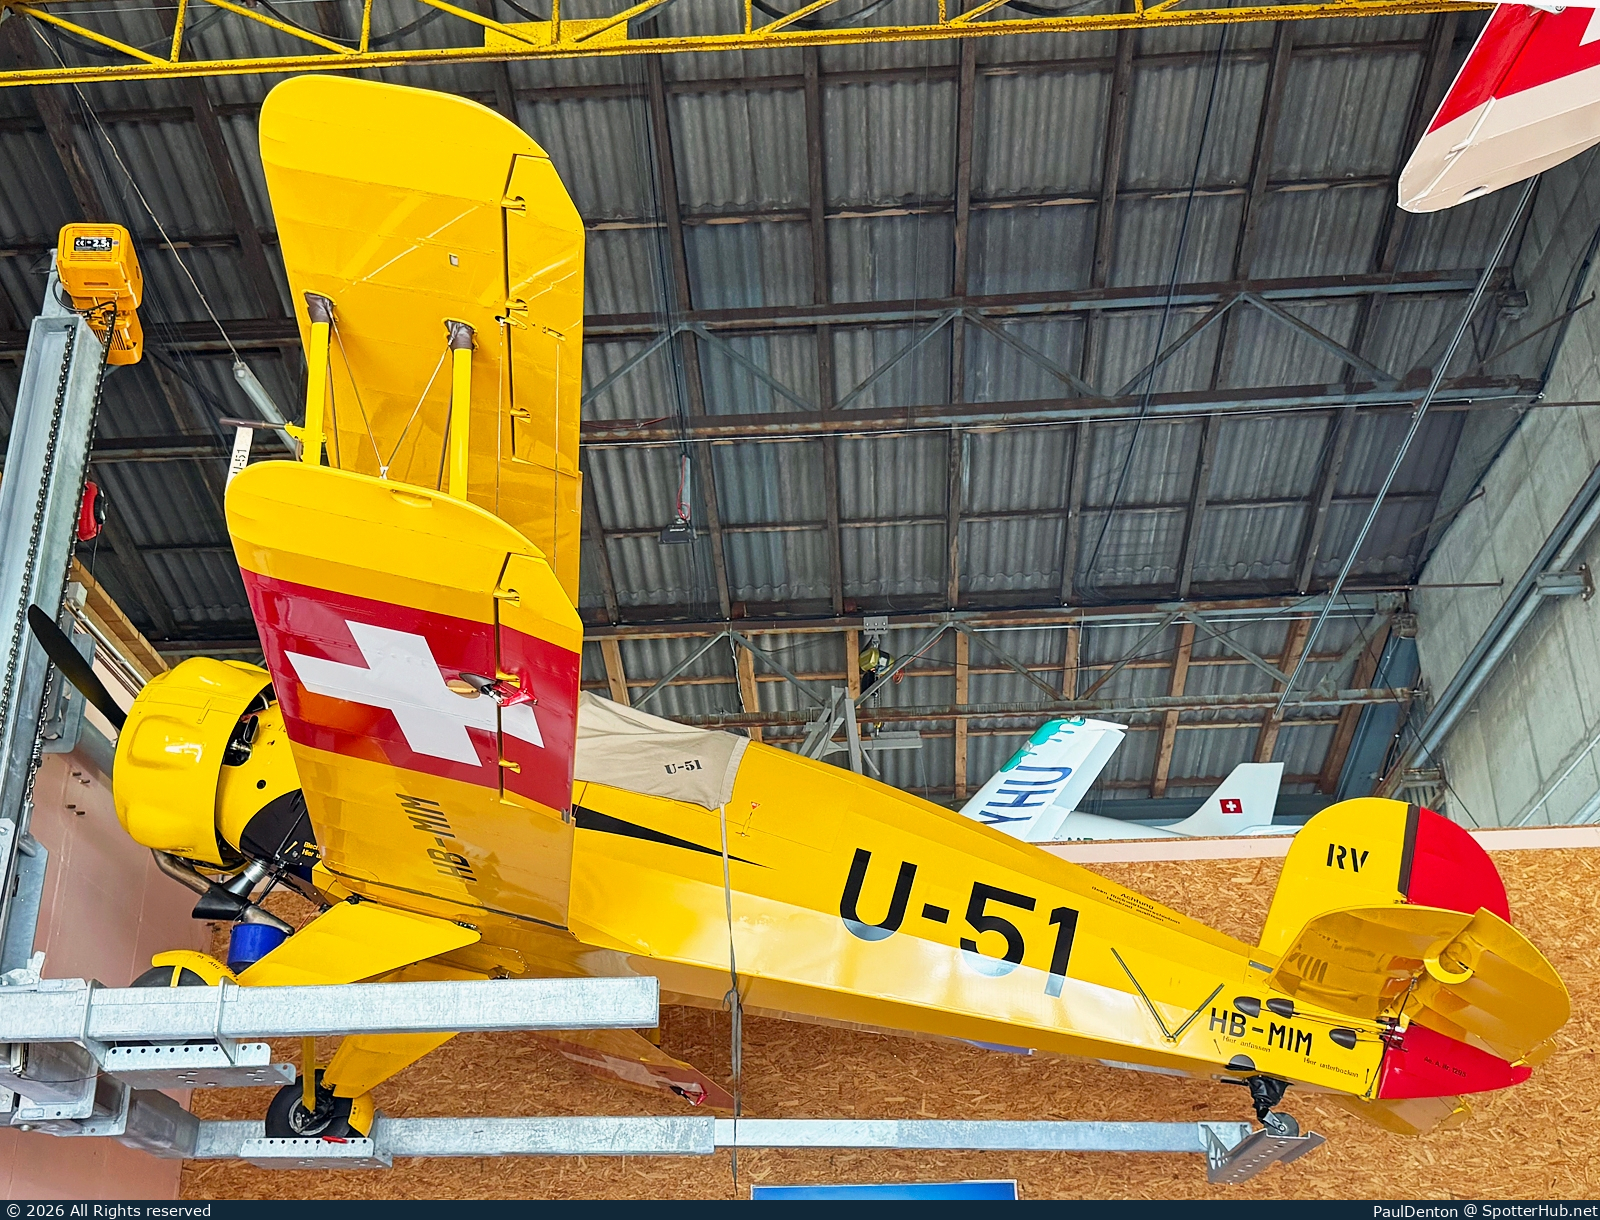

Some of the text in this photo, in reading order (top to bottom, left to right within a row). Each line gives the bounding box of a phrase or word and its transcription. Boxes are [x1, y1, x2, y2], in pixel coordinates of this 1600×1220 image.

[664, 759, 703, 774] U-51
[395, 792, 478, 882] HB-MIM
[1326, 843, 1370, 873] RV
[1120, 893, 1155, 910] Achtung
[839, 847, 1080, 999] U-51
[1209, 1007, 1313, 1056] HB-MIM
[1222, 1035, 1271, 1053] Hier anfassen
[1303, 1056, 1317, 1066] Hier
